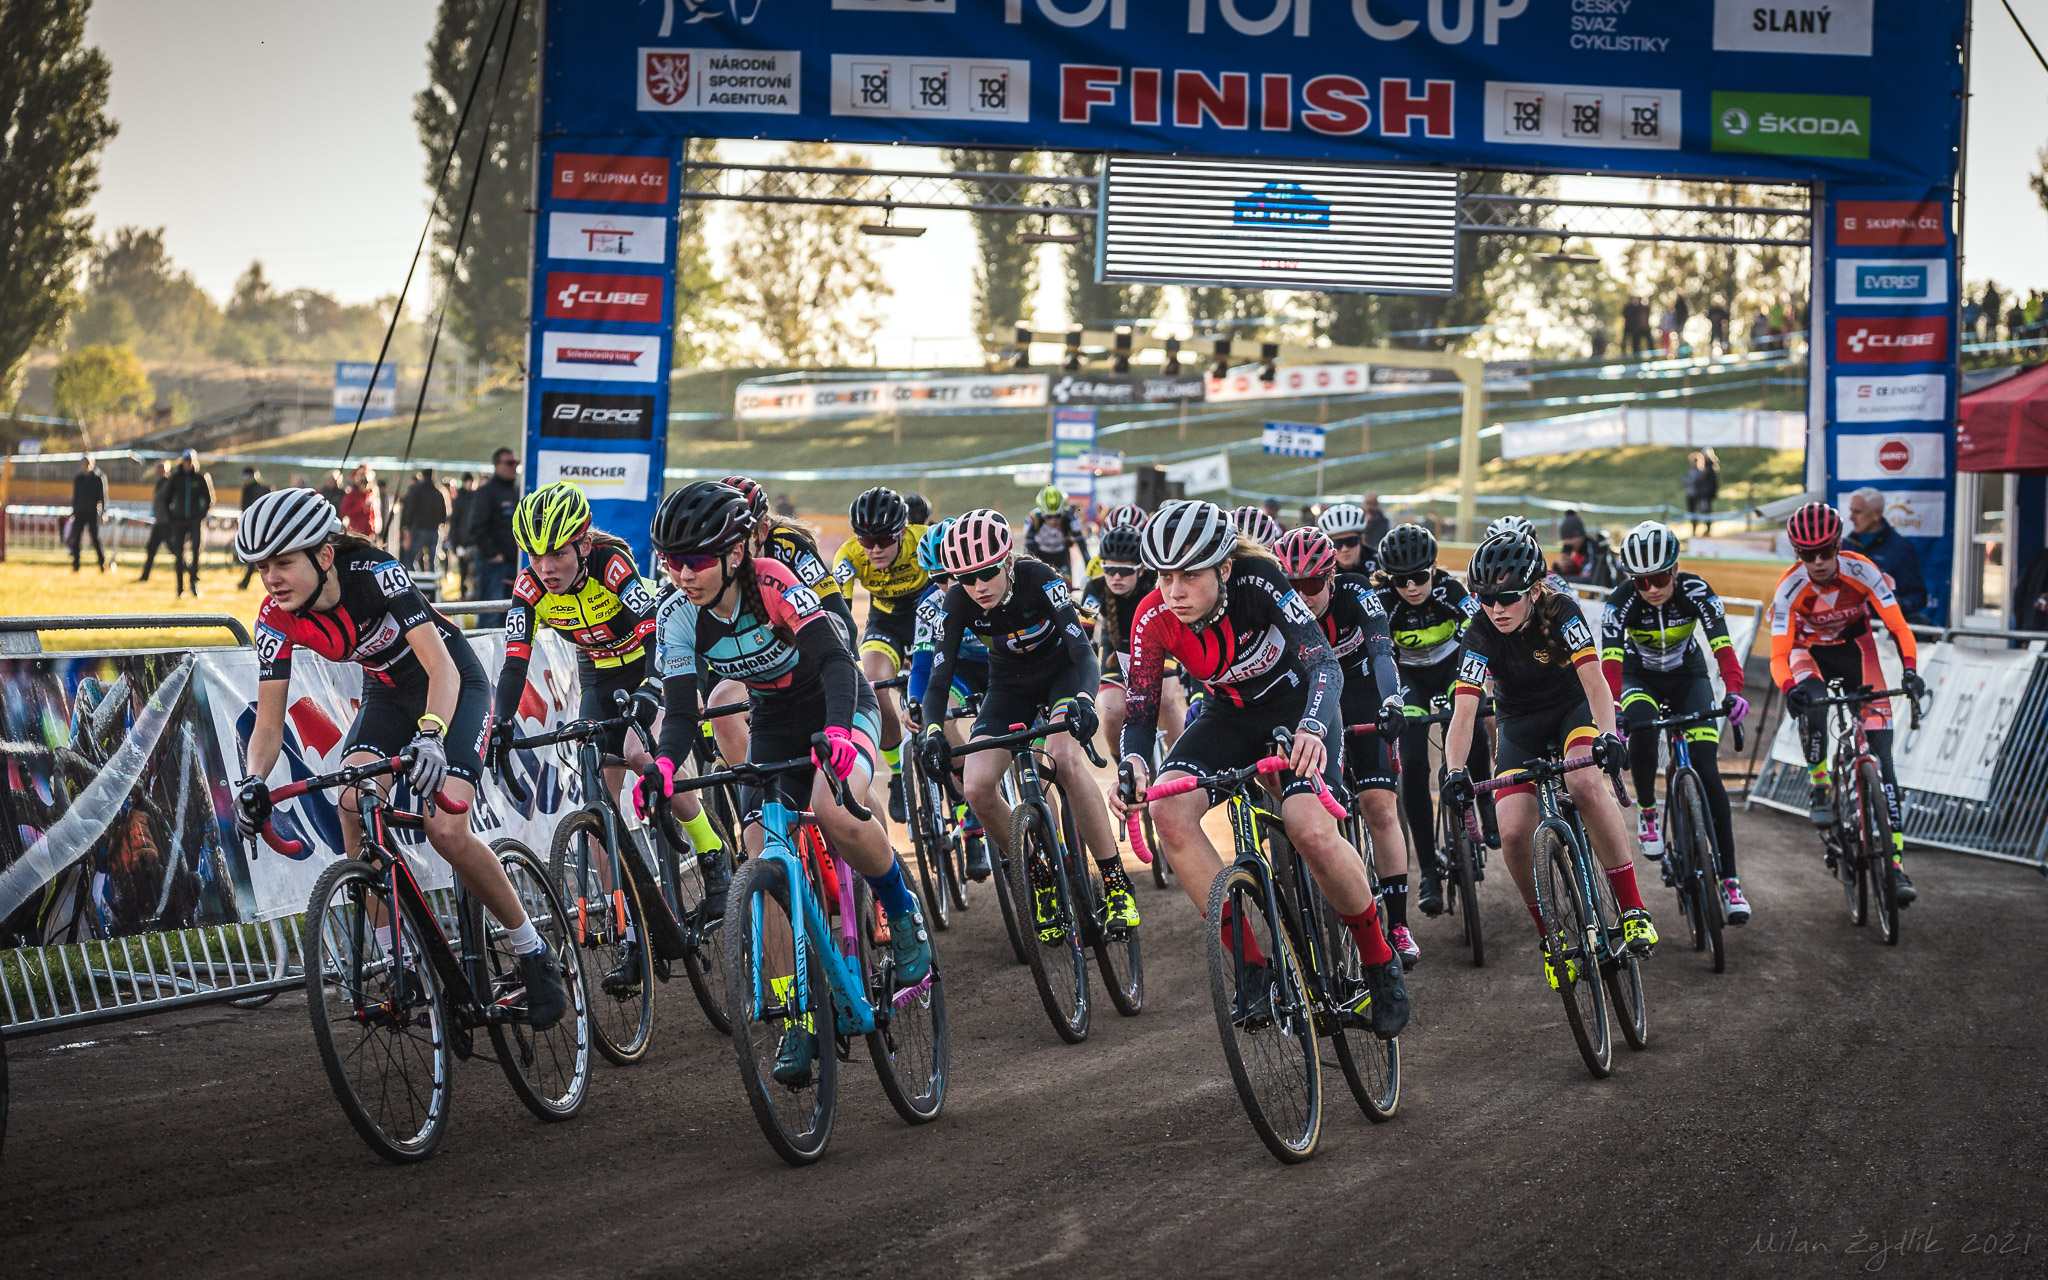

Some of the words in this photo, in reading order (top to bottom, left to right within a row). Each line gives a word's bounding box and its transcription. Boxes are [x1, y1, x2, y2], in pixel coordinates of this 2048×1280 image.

[1570, 16, 1617, 32] SVAZ
[1753, 5, 1832, 34] SLANÝ
[1570, 34, 1670, 52] CYKLISTIKY
[709, 54, 776, 71] NÁRODNÍ
[709, 74, 792, 89] SPORTOVNÍ
[709, 92, 787, 106] AGENTURA
[861, 89, 888, 103] TOI
[920, 91, 947, 106] TOI
[979, 93, 1006, 108] TOI
[1060, 64, 1455, 139] FINISH
[1513, 116, 1540, 131] TOI
[1572, 119, 1599, 134] TOI
[1631, 122, 1658, 136] TOI
[1758, 112, 1860, 135] ŠKODA
[583, 171, 637, 184] SKUPINA
[640, 171, 663, 186] ČEZ
[1864, 275, 1920, 289] EVEREST
[578, 291, 649, 305] CUBE
[1867, 333, 1935, 346] CUBE
[580, 408, 644, 422] FORCE
[801, 560, 820, 582] 57
[835, 564, 851, 580] 52
[383, 568, 407, 591] 46
[625, 586, 650, 611] 56
[794, 590, 817, 609] 41
[1052, 585, 1068, 604] 42
[1366, 595, 1381, 612] 45
[919, 605, 936, 621] 49
[507, 615, 524, 634] 56
[1134, 603, 1169, 666] INTERGA
[1568, 623, 1586, 646] 47
[256, 633, 278, 659] 46
[1463, 660, 1483, 679] 47
